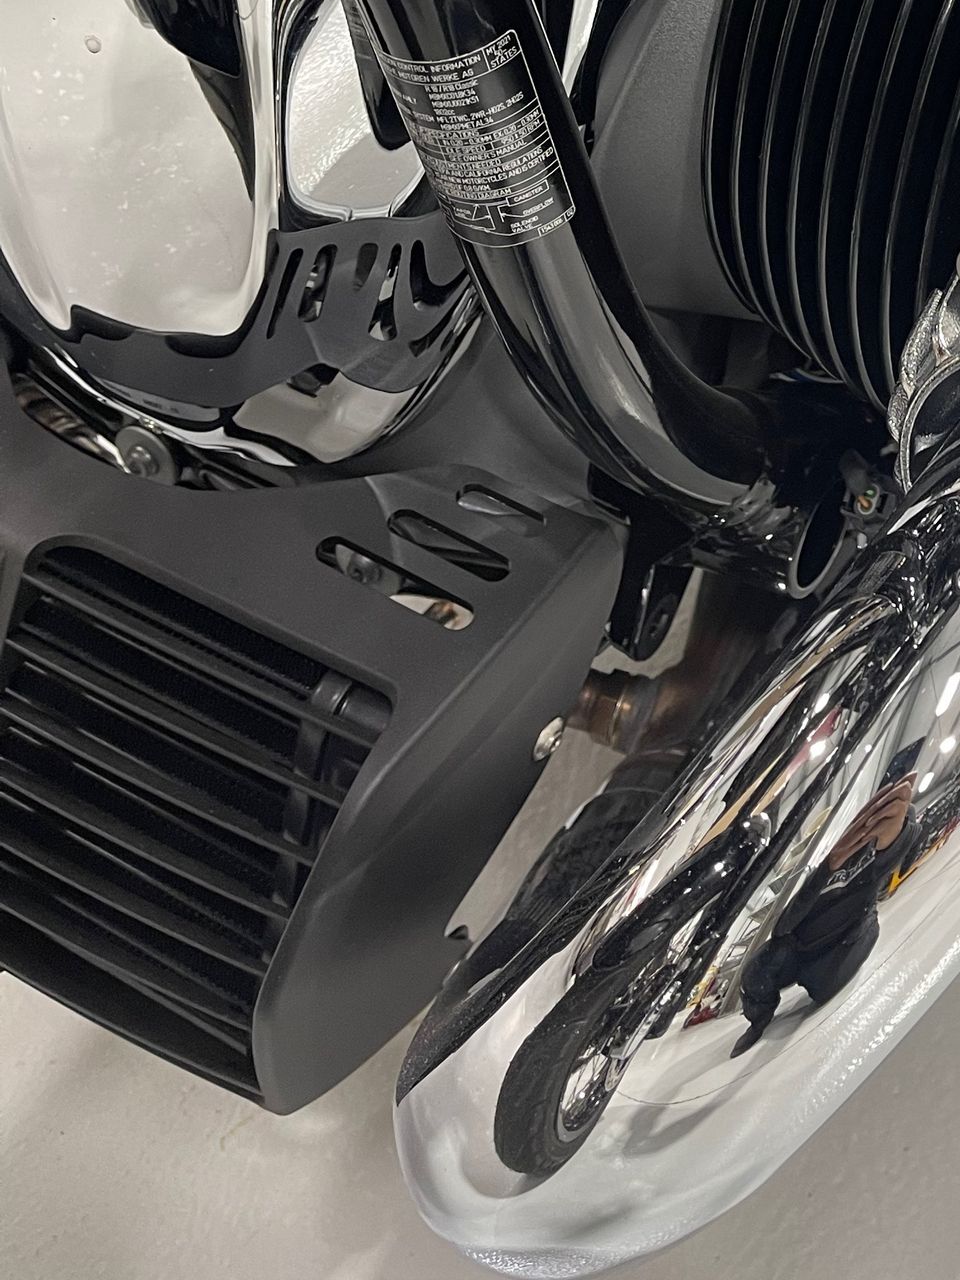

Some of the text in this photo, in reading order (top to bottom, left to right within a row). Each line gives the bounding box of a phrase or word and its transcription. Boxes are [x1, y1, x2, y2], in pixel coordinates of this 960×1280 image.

[485, 35, 511, 56] MY 2021
[429, 54, 481, 71] INFORMATION
[489, 46, 518, 67] STATES
[430, 72, 459, 83] WERKE
[460, 68, 474, 78] AG
[495, 138, 527, 156] MANUAL
